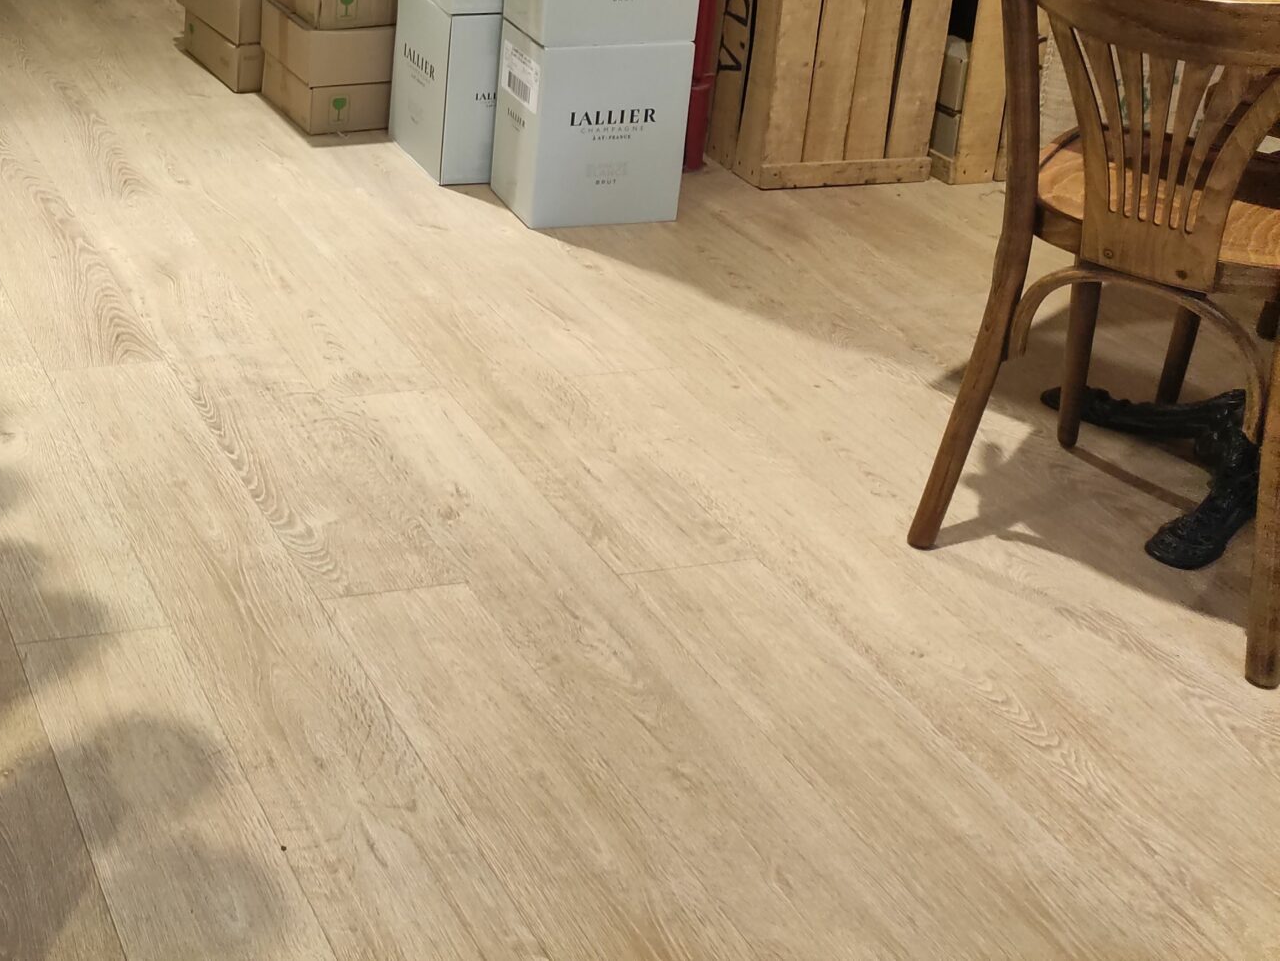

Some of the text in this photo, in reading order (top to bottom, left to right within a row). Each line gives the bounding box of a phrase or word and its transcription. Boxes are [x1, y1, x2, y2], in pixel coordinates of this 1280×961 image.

[403, 42, 435, 81] LALLIER
[570, 108, 656, 127] LALLIER
[580, 126, 644, 134] CHAMPAGNE
